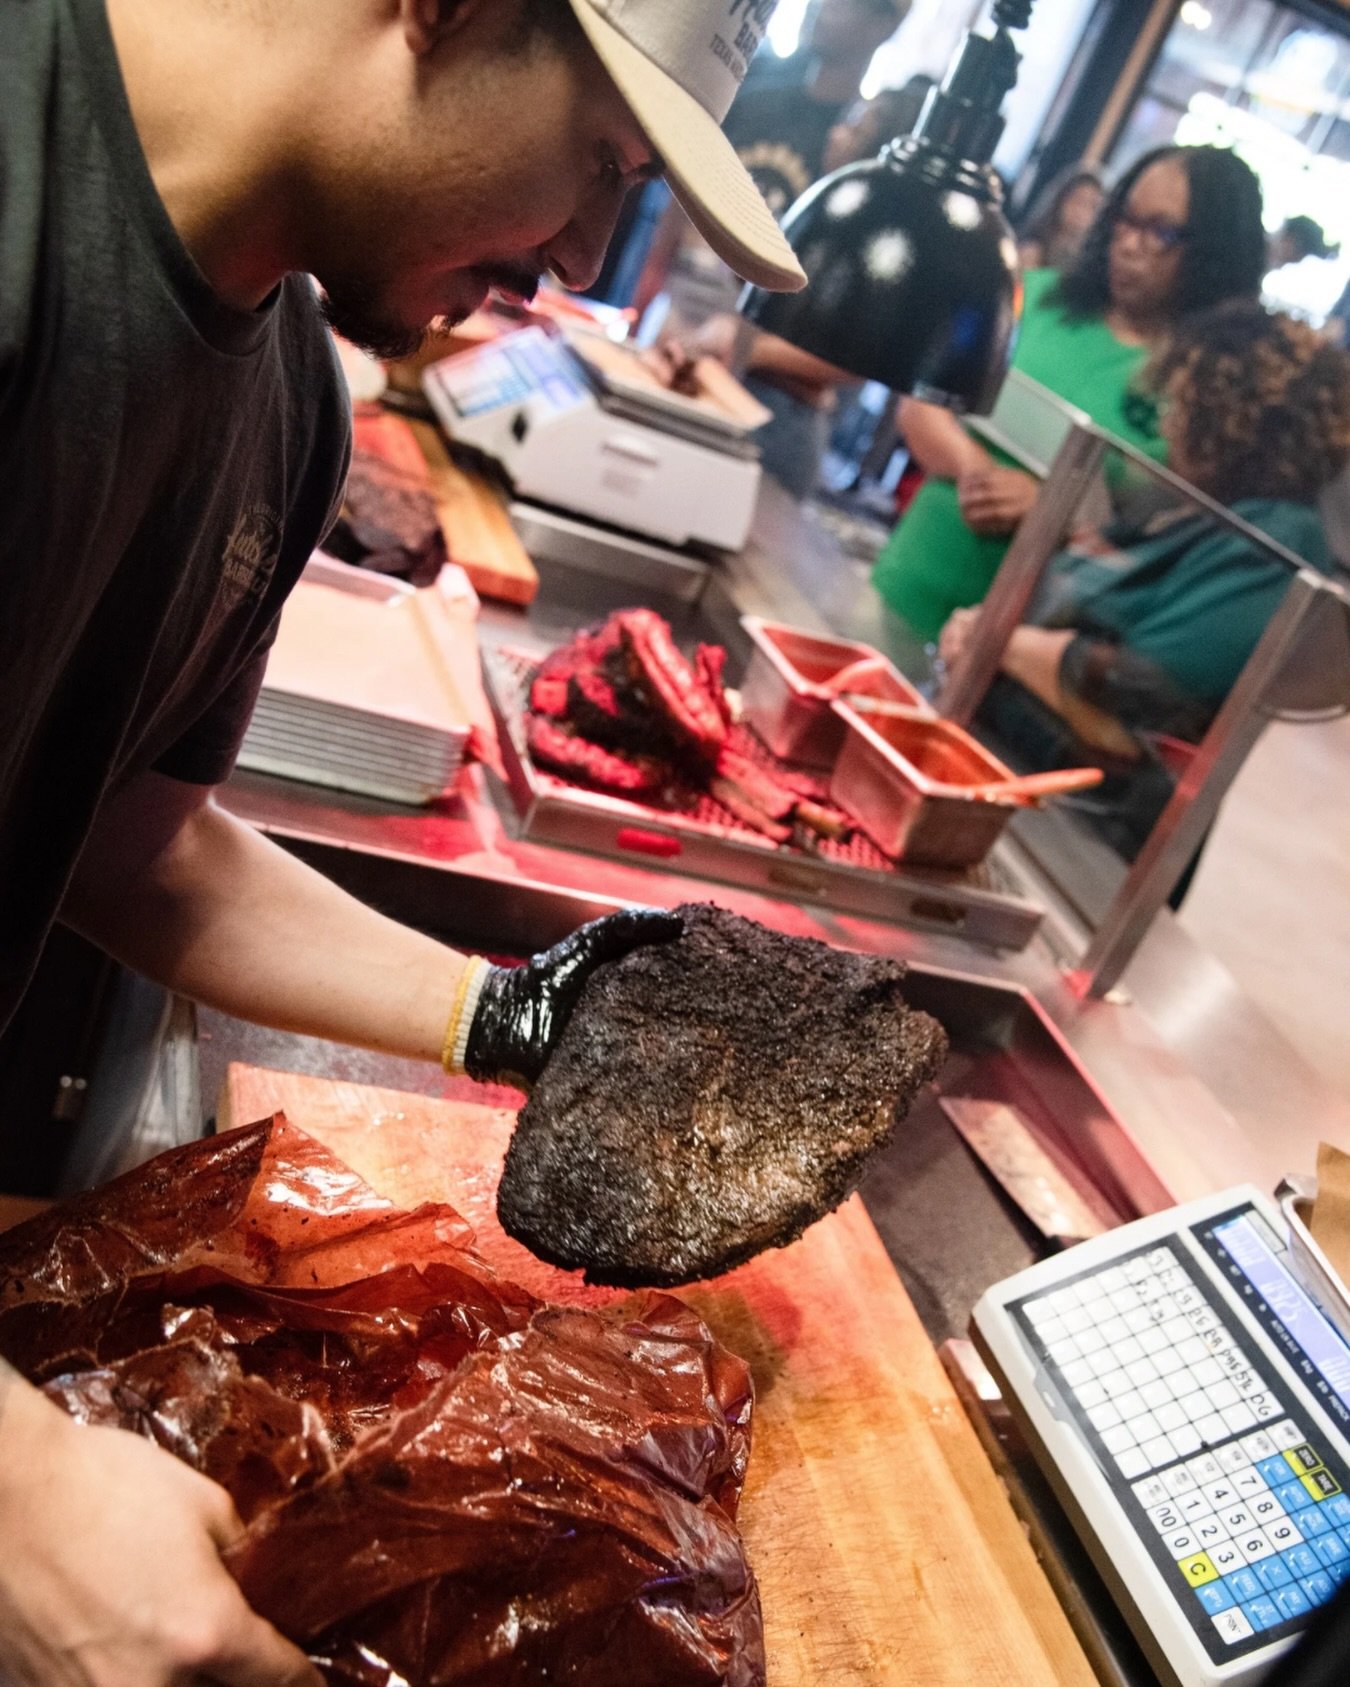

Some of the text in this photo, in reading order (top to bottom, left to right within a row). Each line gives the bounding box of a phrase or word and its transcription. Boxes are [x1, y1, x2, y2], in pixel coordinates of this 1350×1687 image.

[1298, 1448, 1315, 1465] ZERO
[1240, 1476, 1257, 1486] 7
[1316, 1474, 1333, 1491] TARE
[1213, 1489, 1229, 1499] 4
[1187, 1501, 1200, 1509] 1
[1257, 1502, 1273, 1513] 8
[1154, 1508, 1176, 1527] 00
[1230, 1514, 1246, 1524] 5
[1202, 1526, 1217, 1537] 2
[1275, 1528, 1290, 1539] 9
[1174, 1538, 1189, 1548] 0
[1247, 1540, 1263, 1551] 6
[1218, 1552, 1234, 1563] 3
[1190, 1563, 1206, 1575] C
